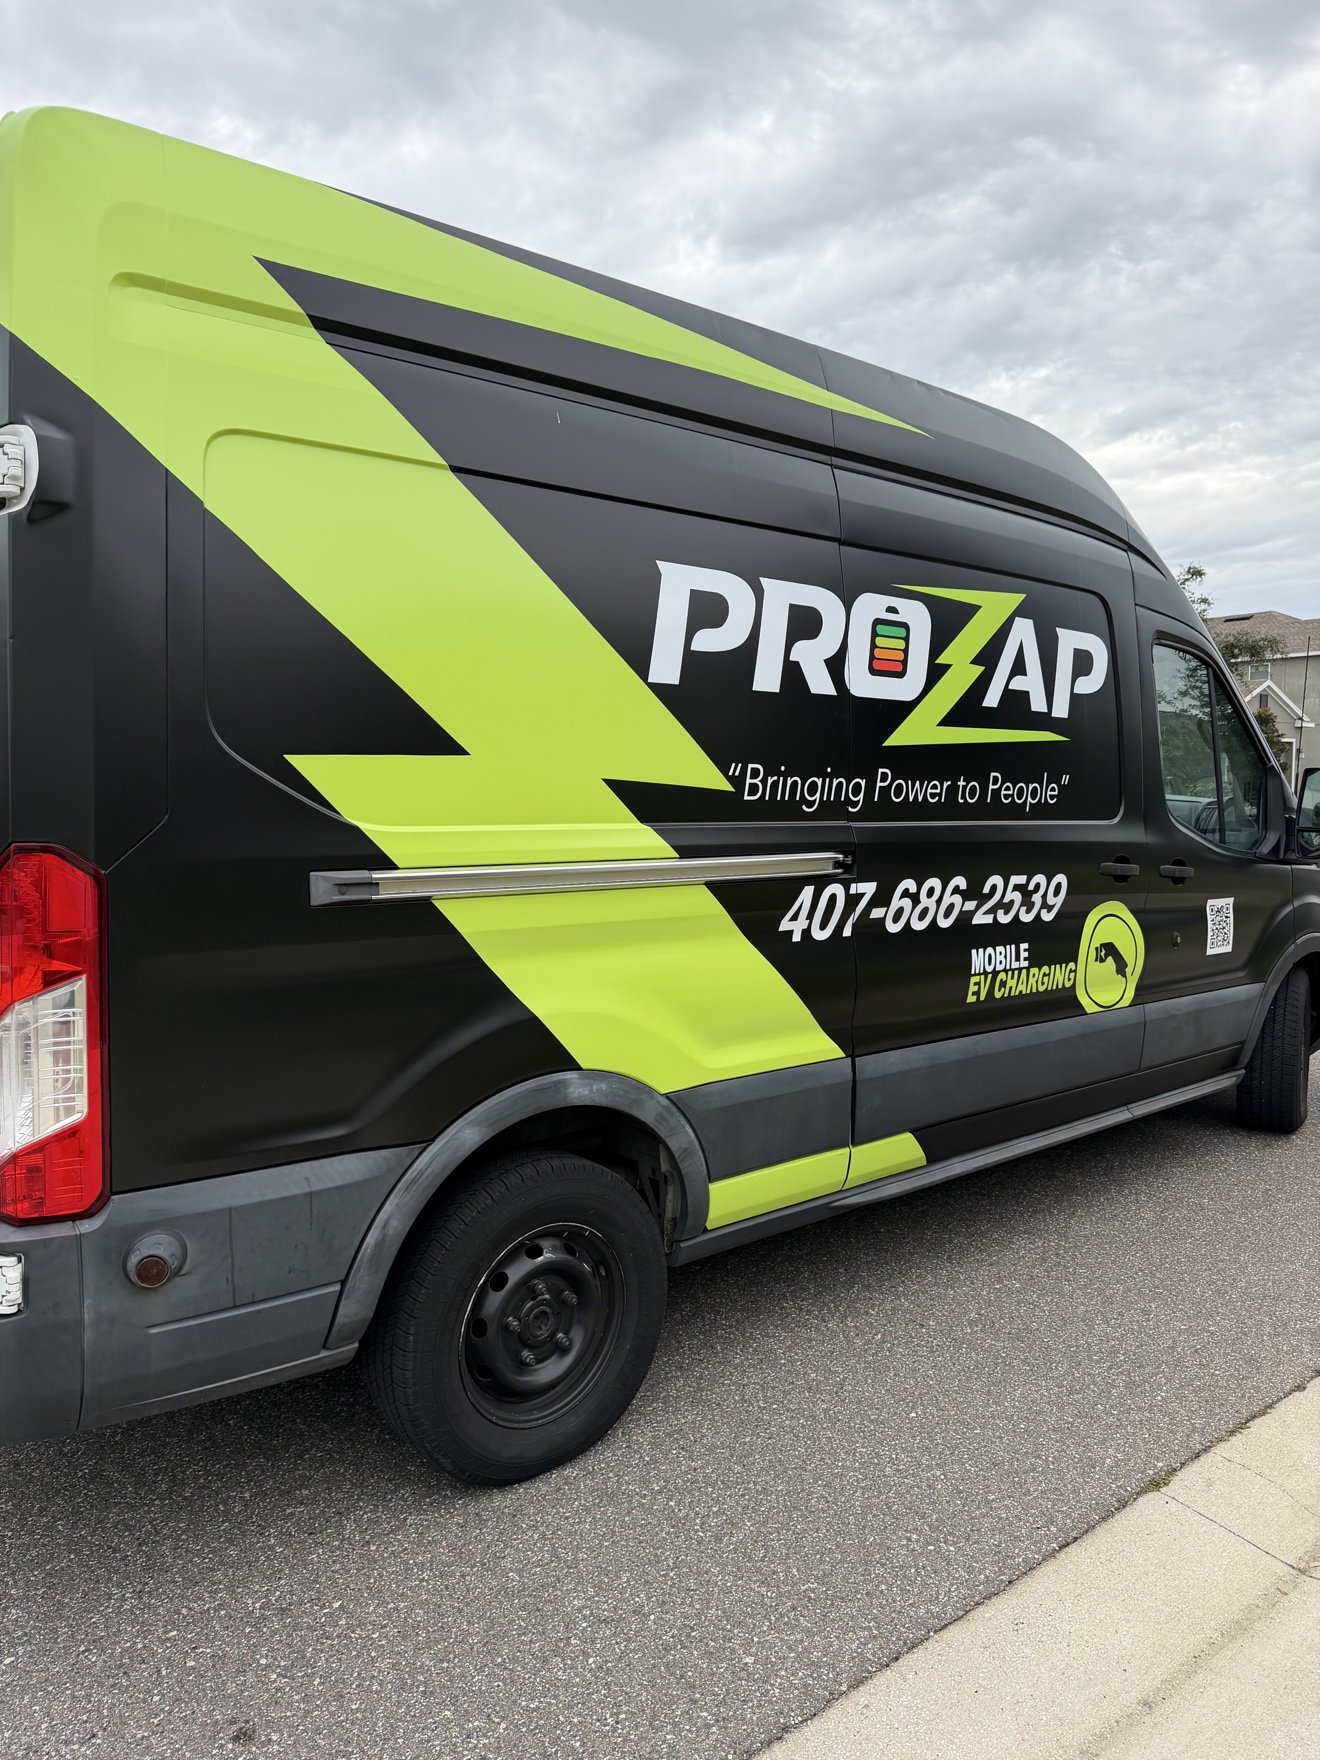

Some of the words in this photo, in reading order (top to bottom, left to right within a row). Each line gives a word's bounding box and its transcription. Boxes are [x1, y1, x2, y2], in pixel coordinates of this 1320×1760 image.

[648, 559, 1109, 746] PROZAP
[874, 767, 951, 803] Power
[957, 774, 980, 804] to
[778, 873, 1068, 942] 407-686-2539
[971, 943, 1029, 974] MOBILE
[966, 972, 992, 1003] EV
[994, 961, 1075, 1000] CHARGING
